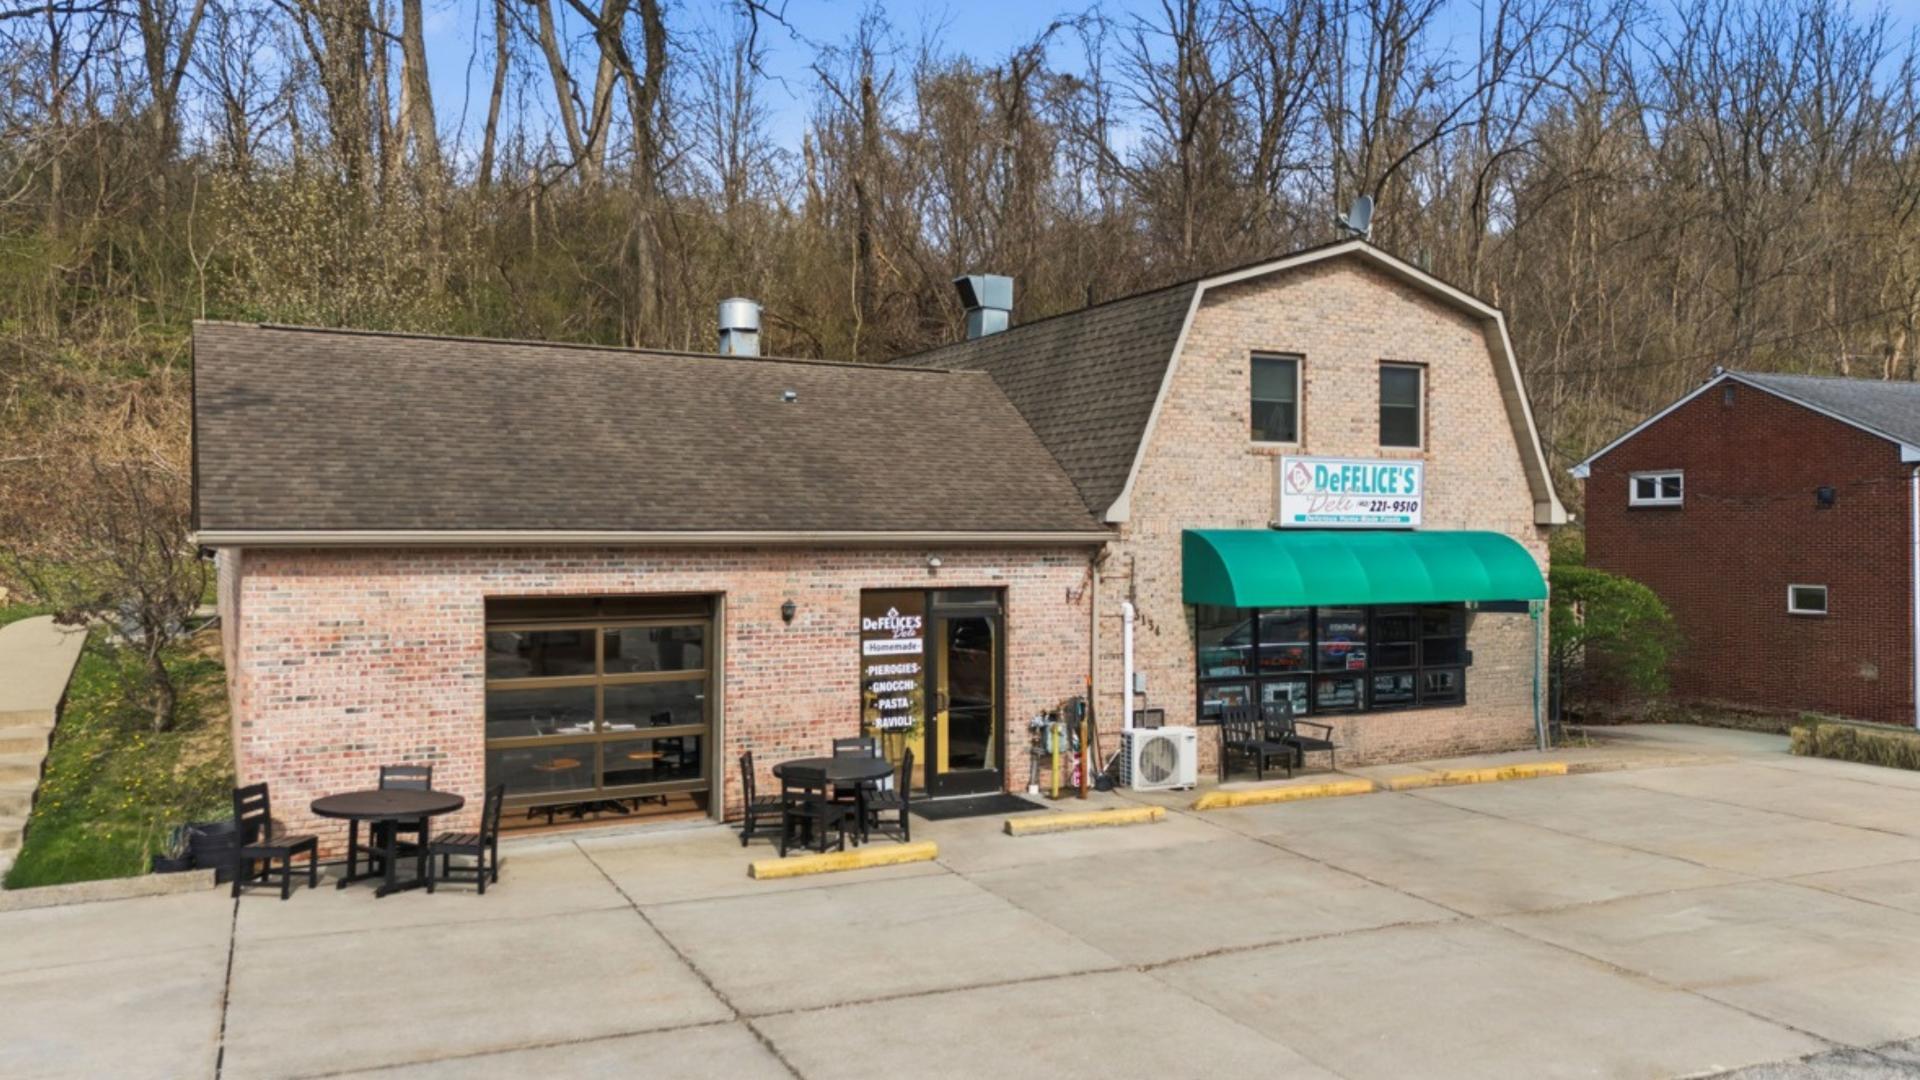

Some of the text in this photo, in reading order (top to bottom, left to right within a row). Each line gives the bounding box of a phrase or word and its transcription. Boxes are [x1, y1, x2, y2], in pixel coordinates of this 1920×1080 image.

[1315, 464, 1415, 494] DeFELICE'S
[1306, 487, 1353, 513] Deli
[1369, 500, 1418, 513] 221-9510
